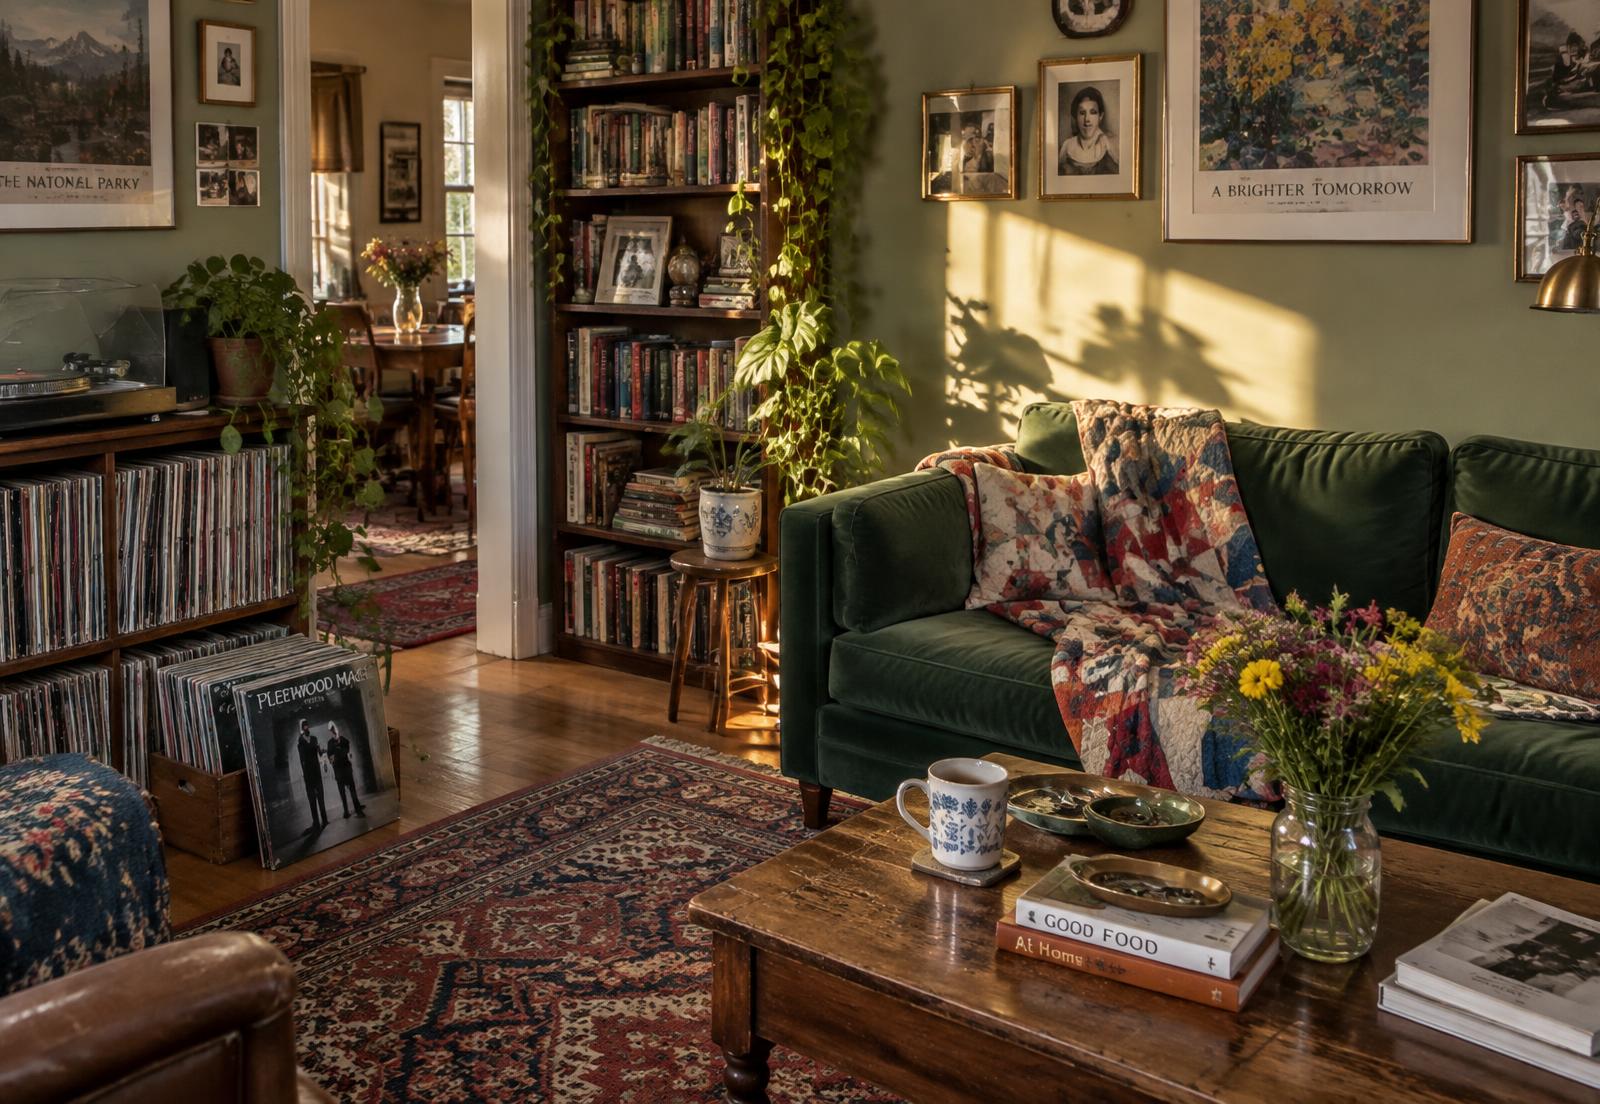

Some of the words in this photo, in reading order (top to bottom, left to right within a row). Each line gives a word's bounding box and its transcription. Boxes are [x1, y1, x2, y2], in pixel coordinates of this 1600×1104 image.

[98, 177, 140, 190] PARKY
[1211, 185, 1221, 198] A
[1228, 183, 1305, 198] BRIGHTER
[1312, 181, 1414, 197] TOMORROW
[1044, 913, 1094, 938] GOOD
[1103, 928, 1158, 956] FOOD
[1015, 935, 1033, 953] At
